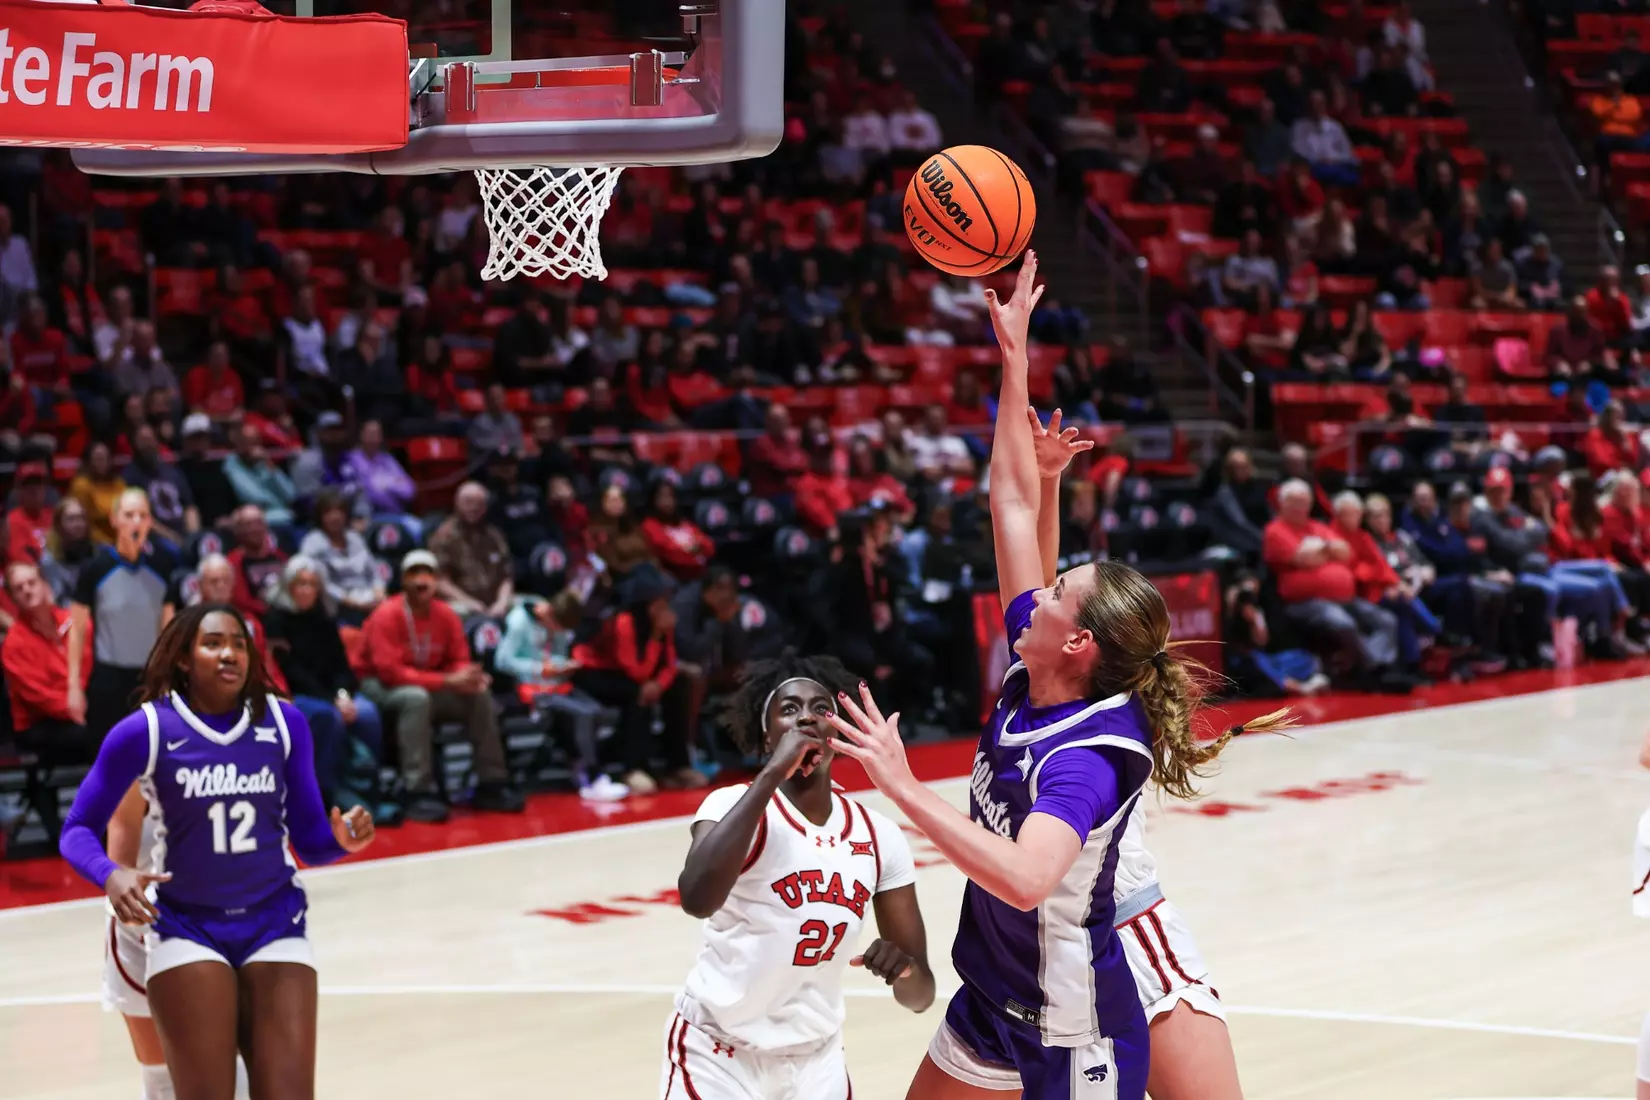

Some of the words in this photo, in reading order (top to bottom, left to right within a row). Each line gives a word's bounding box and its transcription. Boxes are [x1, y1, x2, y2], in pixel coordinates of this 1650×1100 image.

[921, 159, 973, 233] Wilson
[175, 763, 276, 799] Wildcats
[207, 800, 257, 854] 12
[771, 869, 871, 920] UTAH
[792, 919, 848, 966] 21
[1027, 1013, 1035, 1022] M
